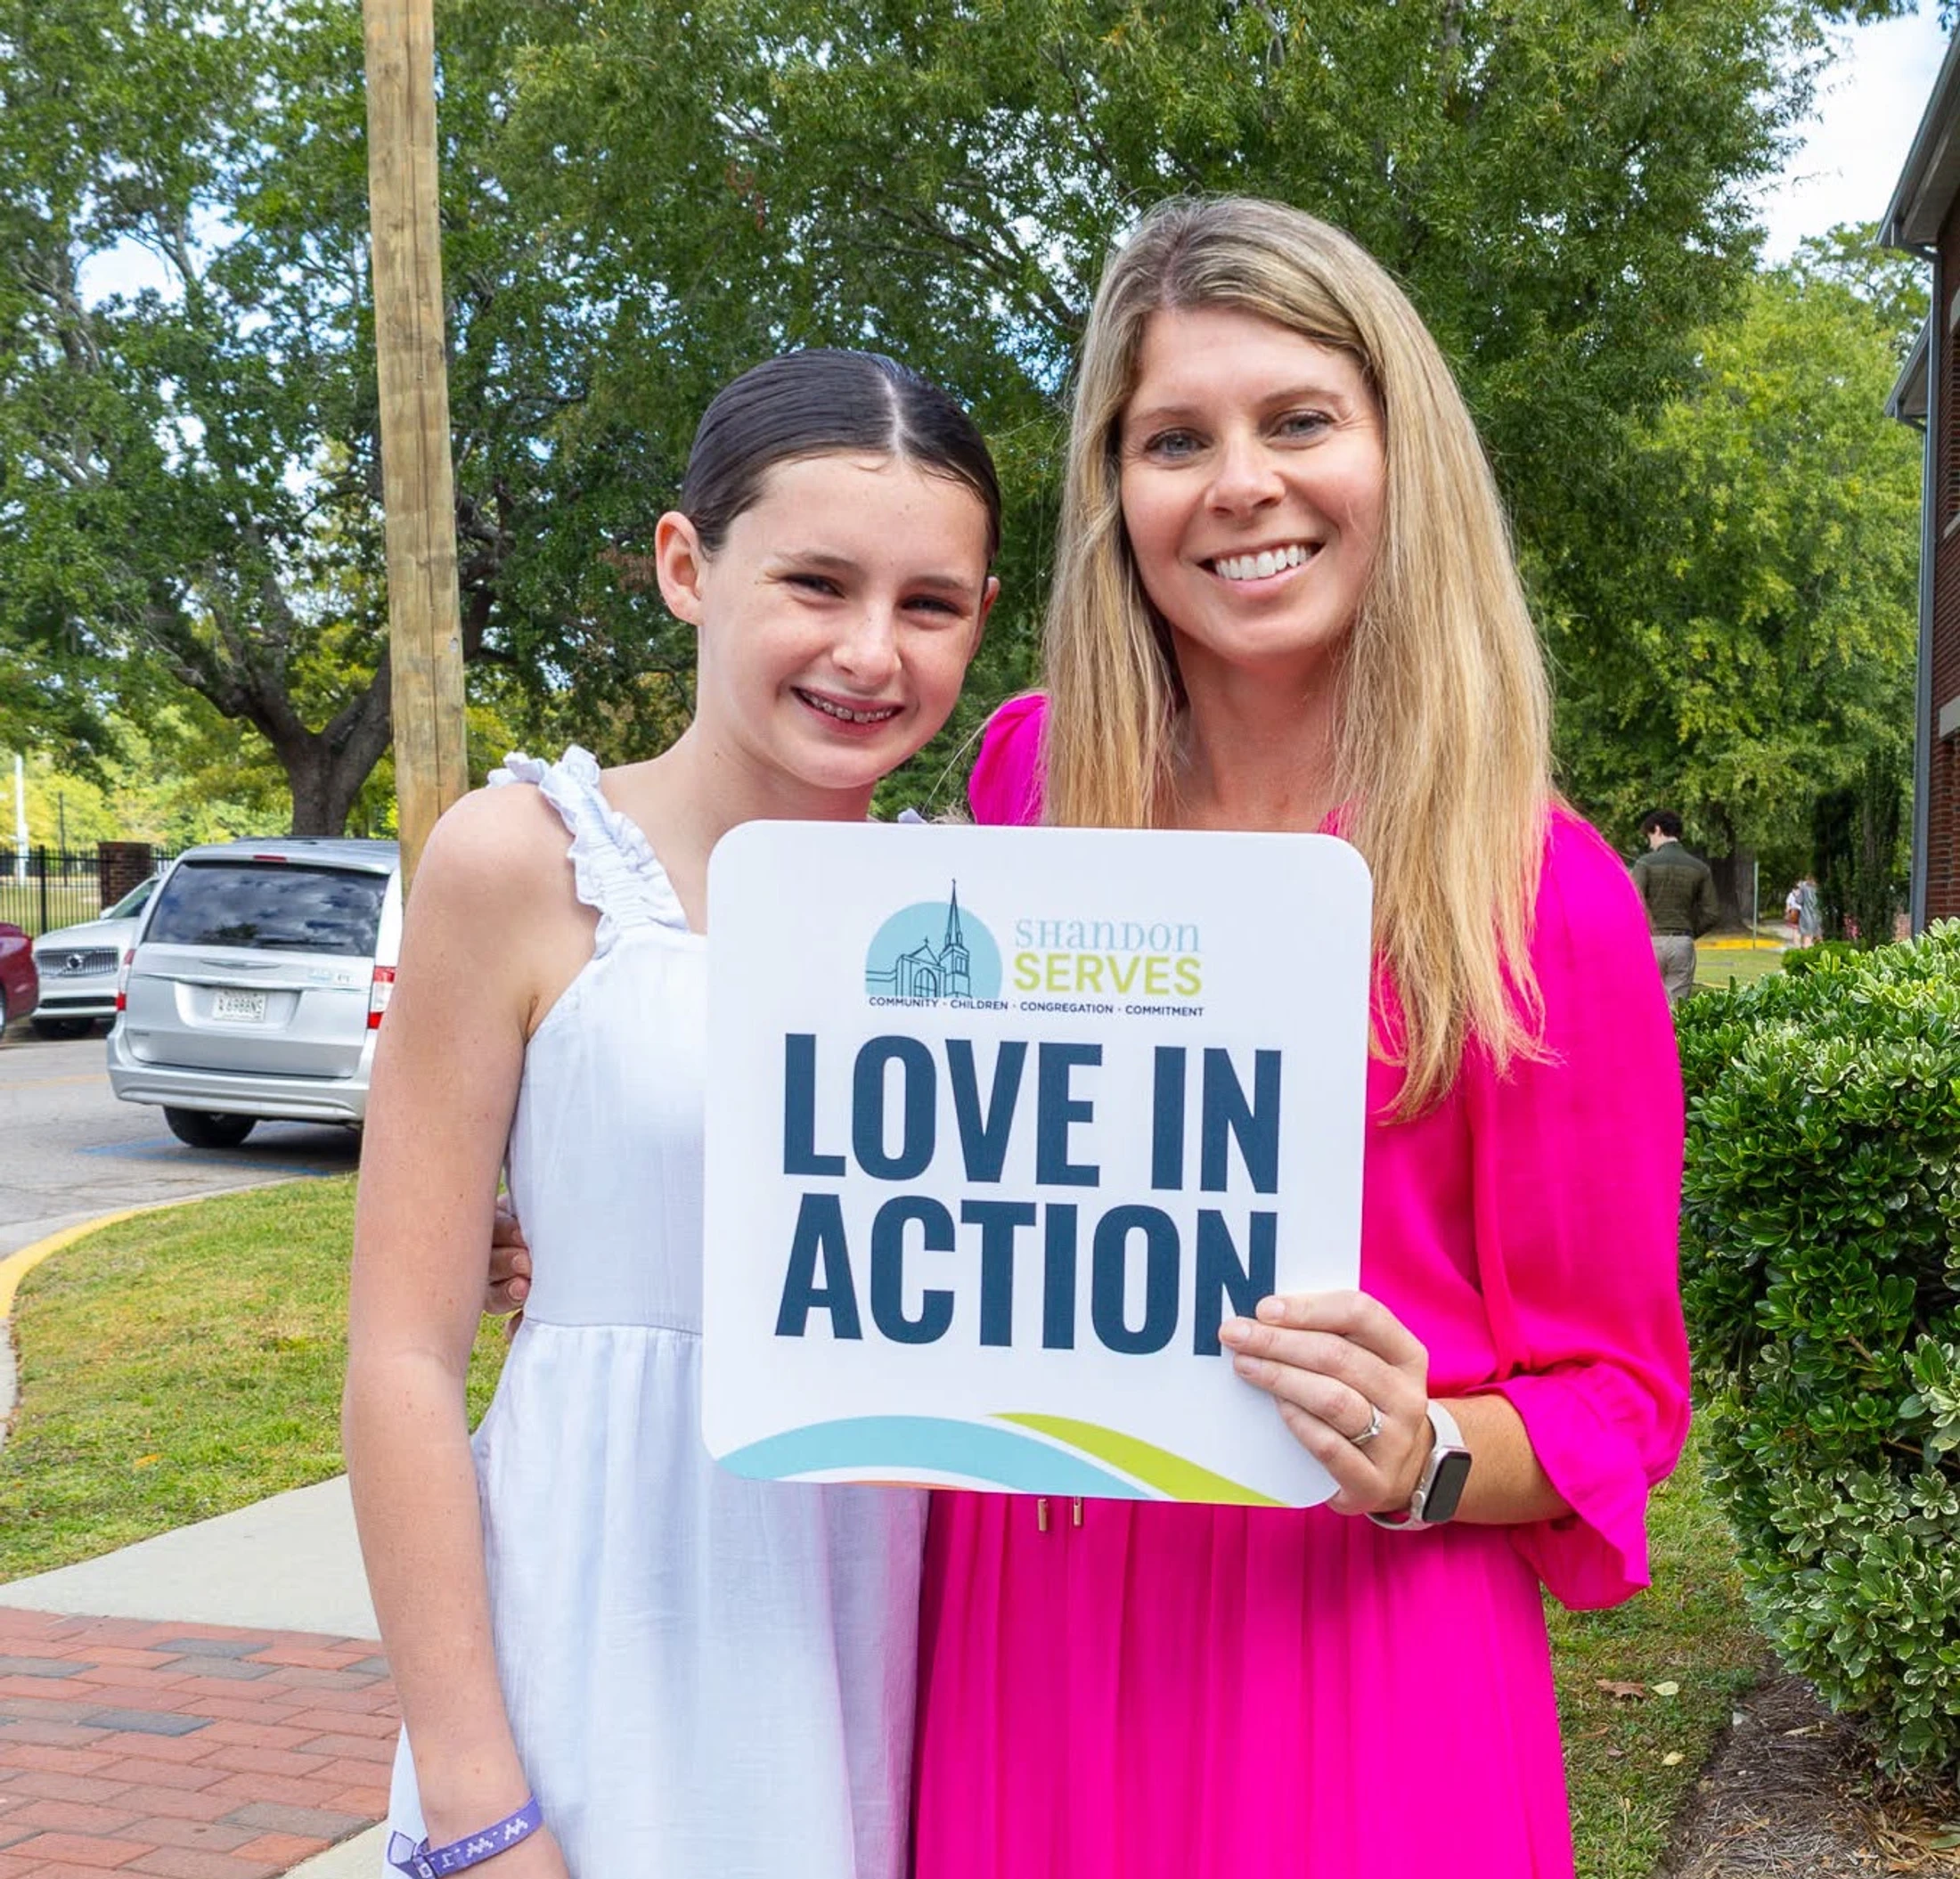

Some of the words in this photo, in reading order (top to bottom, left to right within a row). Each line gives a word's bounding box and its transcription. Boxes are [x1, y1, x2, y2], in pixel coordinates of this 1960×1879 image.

[869, 997, 939, 1008] COMMUNITY
[950, 999, 1009, 1010] CHILDREN
[1019, 1001, 1114, 1014] CONGREGATION
[1125, 1004, 1205, 1017] COMMITMENT
[1014, 952, 1202, 996] SERVES
[783, 1033, 1103, 1187] LOVE
[1151, 1045, 1282, 1195] IN
[775, 1193, 1278, 1357] ACTION
